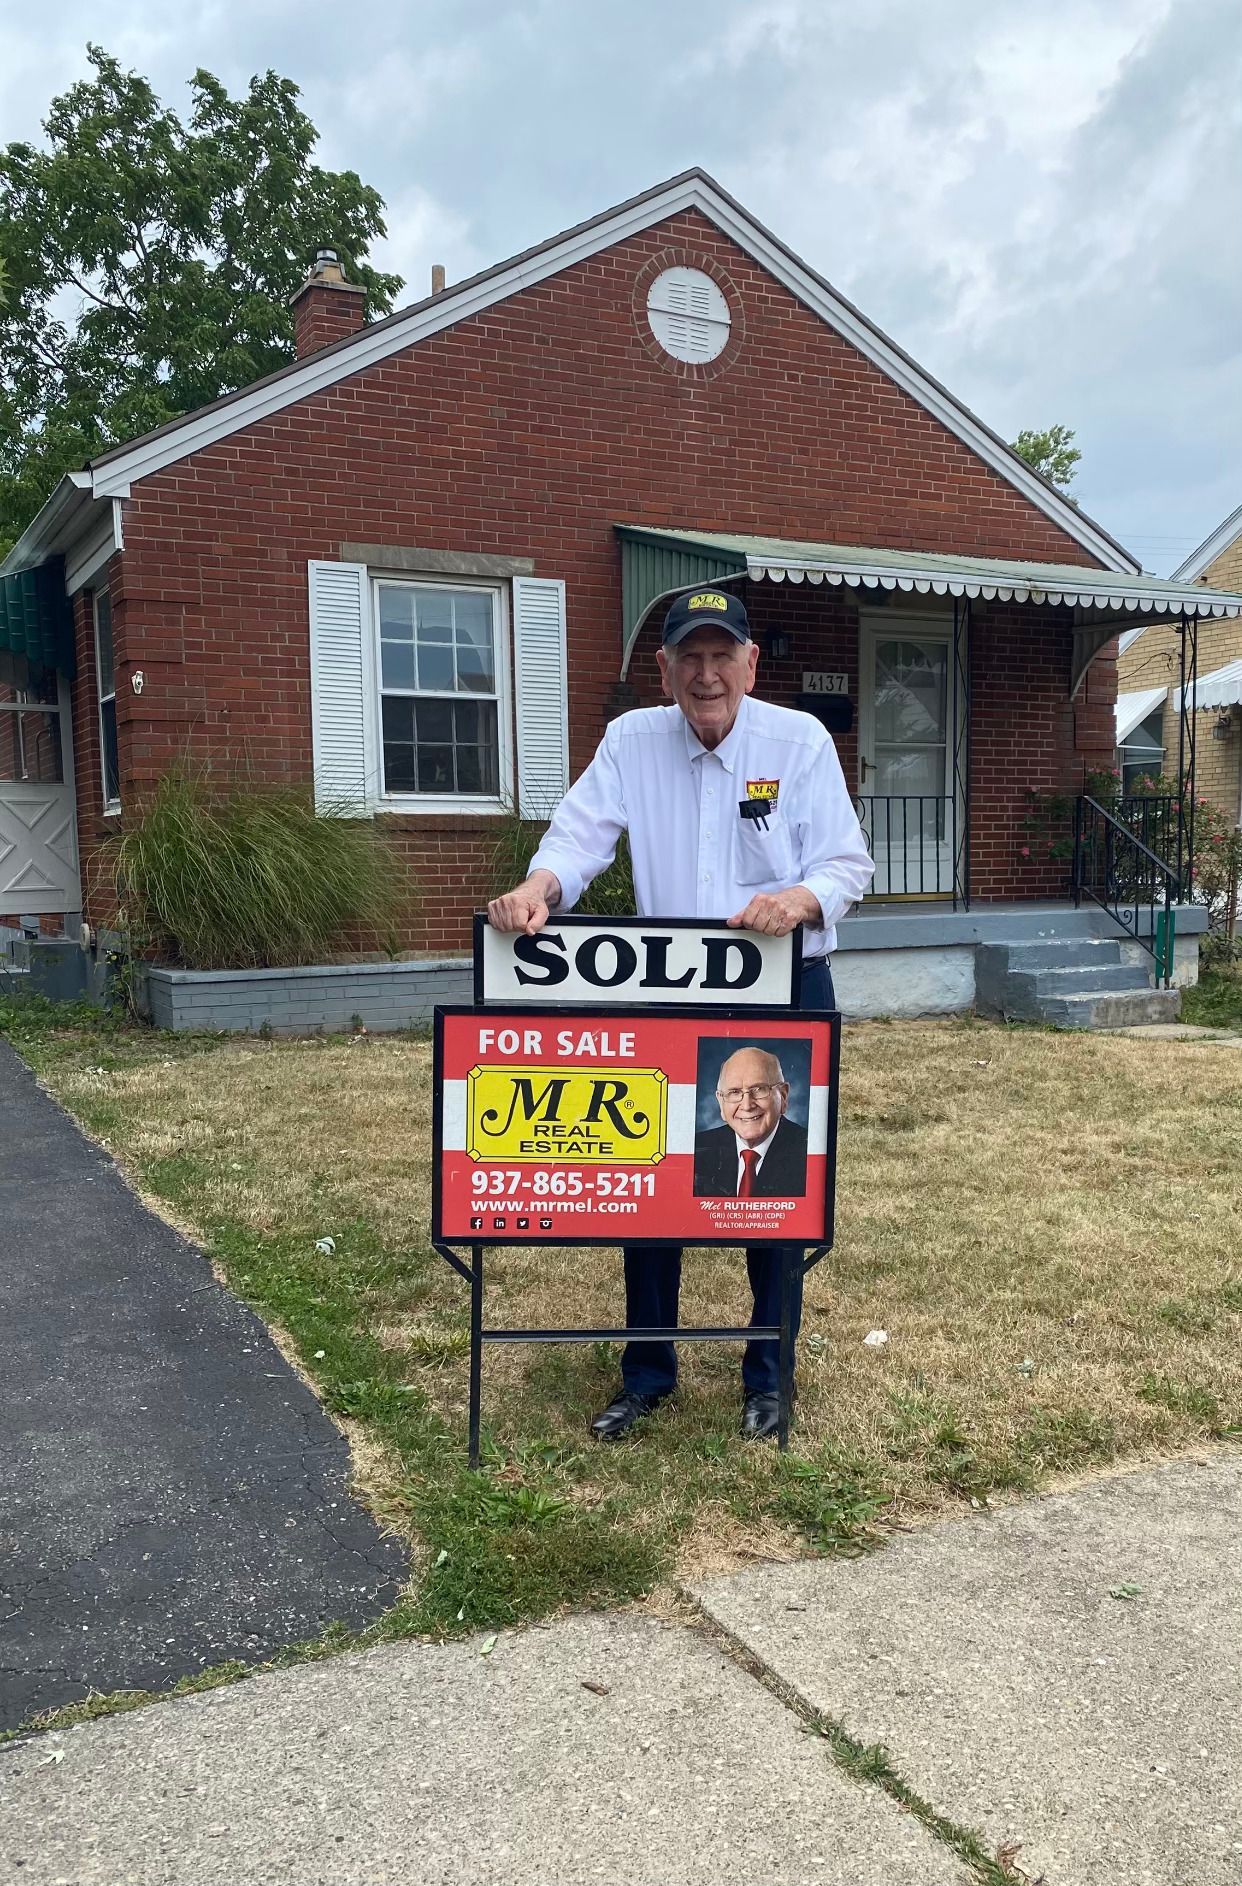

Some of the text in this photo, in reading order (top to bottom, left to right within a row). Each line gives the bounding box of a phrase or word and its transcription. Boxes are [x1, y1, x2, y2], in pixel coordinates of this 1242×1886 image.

[808, 674, 844, 691] 4137
[513, 933, 762, 989] SOLD
[479, 1029, 636, 1057] FOR SALE
[533, 1125, 601, 1138] REAL
[519, 1140, 614, 1154] ESTATE
[471, 1170, 656, 1197] 937-865-5211
[471, 1198, 638, 1213] www.mrmel.com
[699, 1200, 796, 1211] Mel RUTHERFORD
[709, 1212, 726, 1220] (GRI)
[726, 1212, 744, 1220] (CRS)
[745, 1212, 763, 1220] (ABR)
